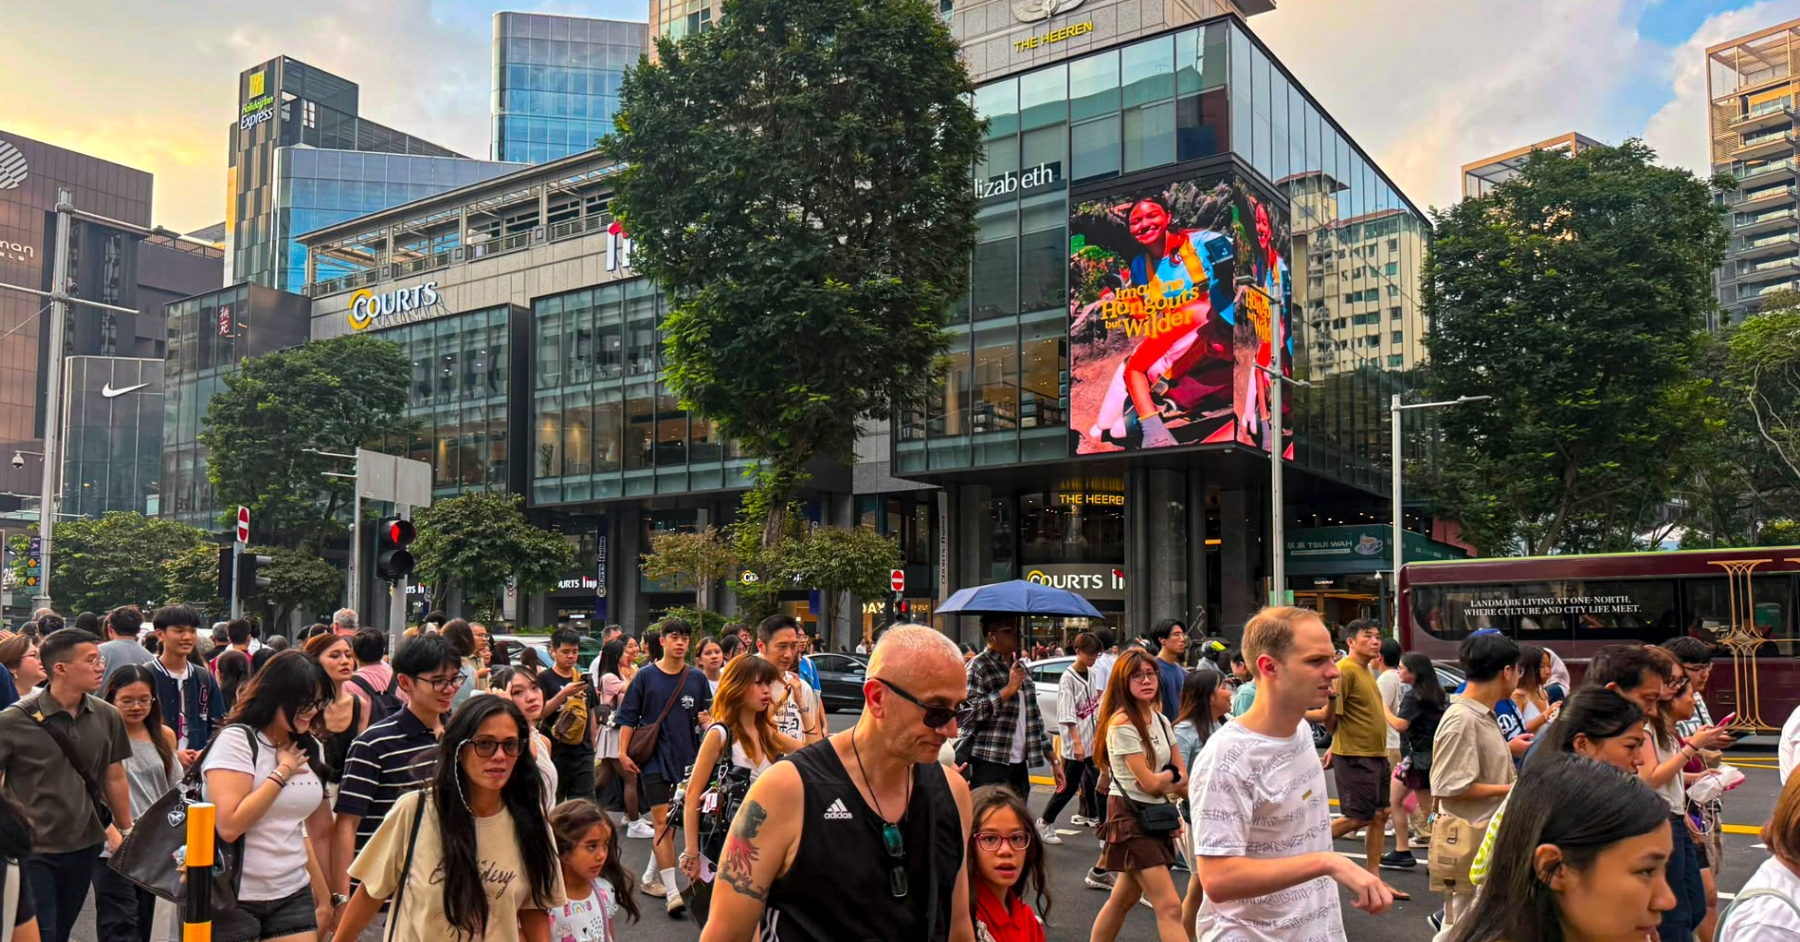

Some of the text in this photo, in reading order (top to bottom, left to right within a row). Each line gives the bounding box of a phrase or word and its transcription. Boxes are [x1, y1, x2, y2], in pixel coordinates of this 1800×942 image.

[1014, 21, 1093, 53] THE HEEREN
[240, 107, 273, 130] Express
[974, 162, 1053, 199] lizabeth
[351, 281, 439, 322] COURTS
[1101, 286, 1200, 320] Hangouts
[1105, 309, 1195, 339] but Wilder
[1059, 494, 1083, 504] THE
[1308, 541, 1329, 549] TSUI
[1330, 540, 1353, 548] WAH
[1464, 604, 1642, 616] WHERE CULTURE AND CITY LIFE MEET.
[1470, 595, 1632, 608] LANDMARK LIVING AT ONE-NORTH.
[823, 810, 853, 819] adidas
